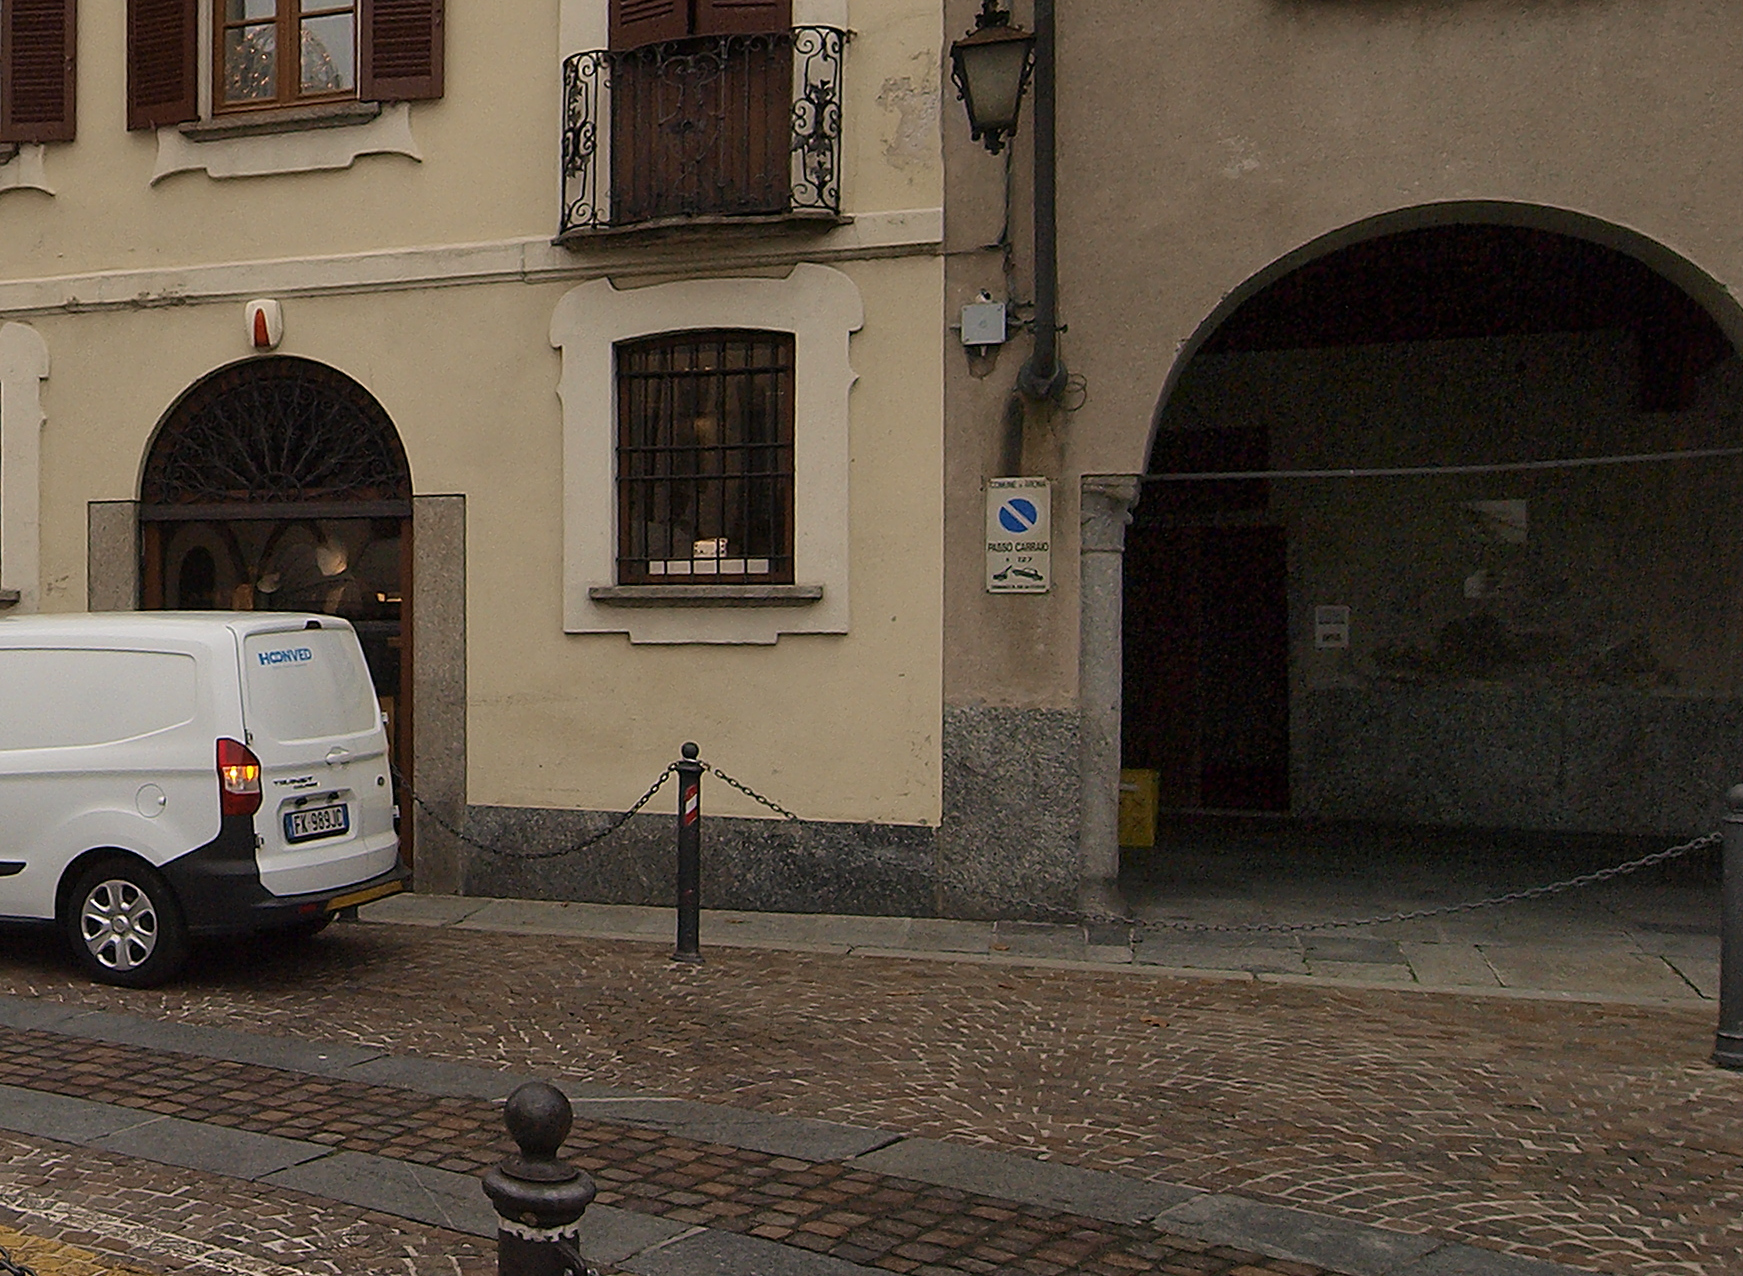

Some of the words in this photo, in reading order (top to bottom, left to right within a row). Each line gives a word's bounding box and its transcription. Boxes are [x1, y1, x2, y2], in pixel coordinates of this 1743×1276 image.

[988, 541, 1013, 552] PASSO
[1015, 541, 1049, 552] CARRAIO
[258, 648, 312, 666] HOONVED
[294, 814, 308, 834] FK
